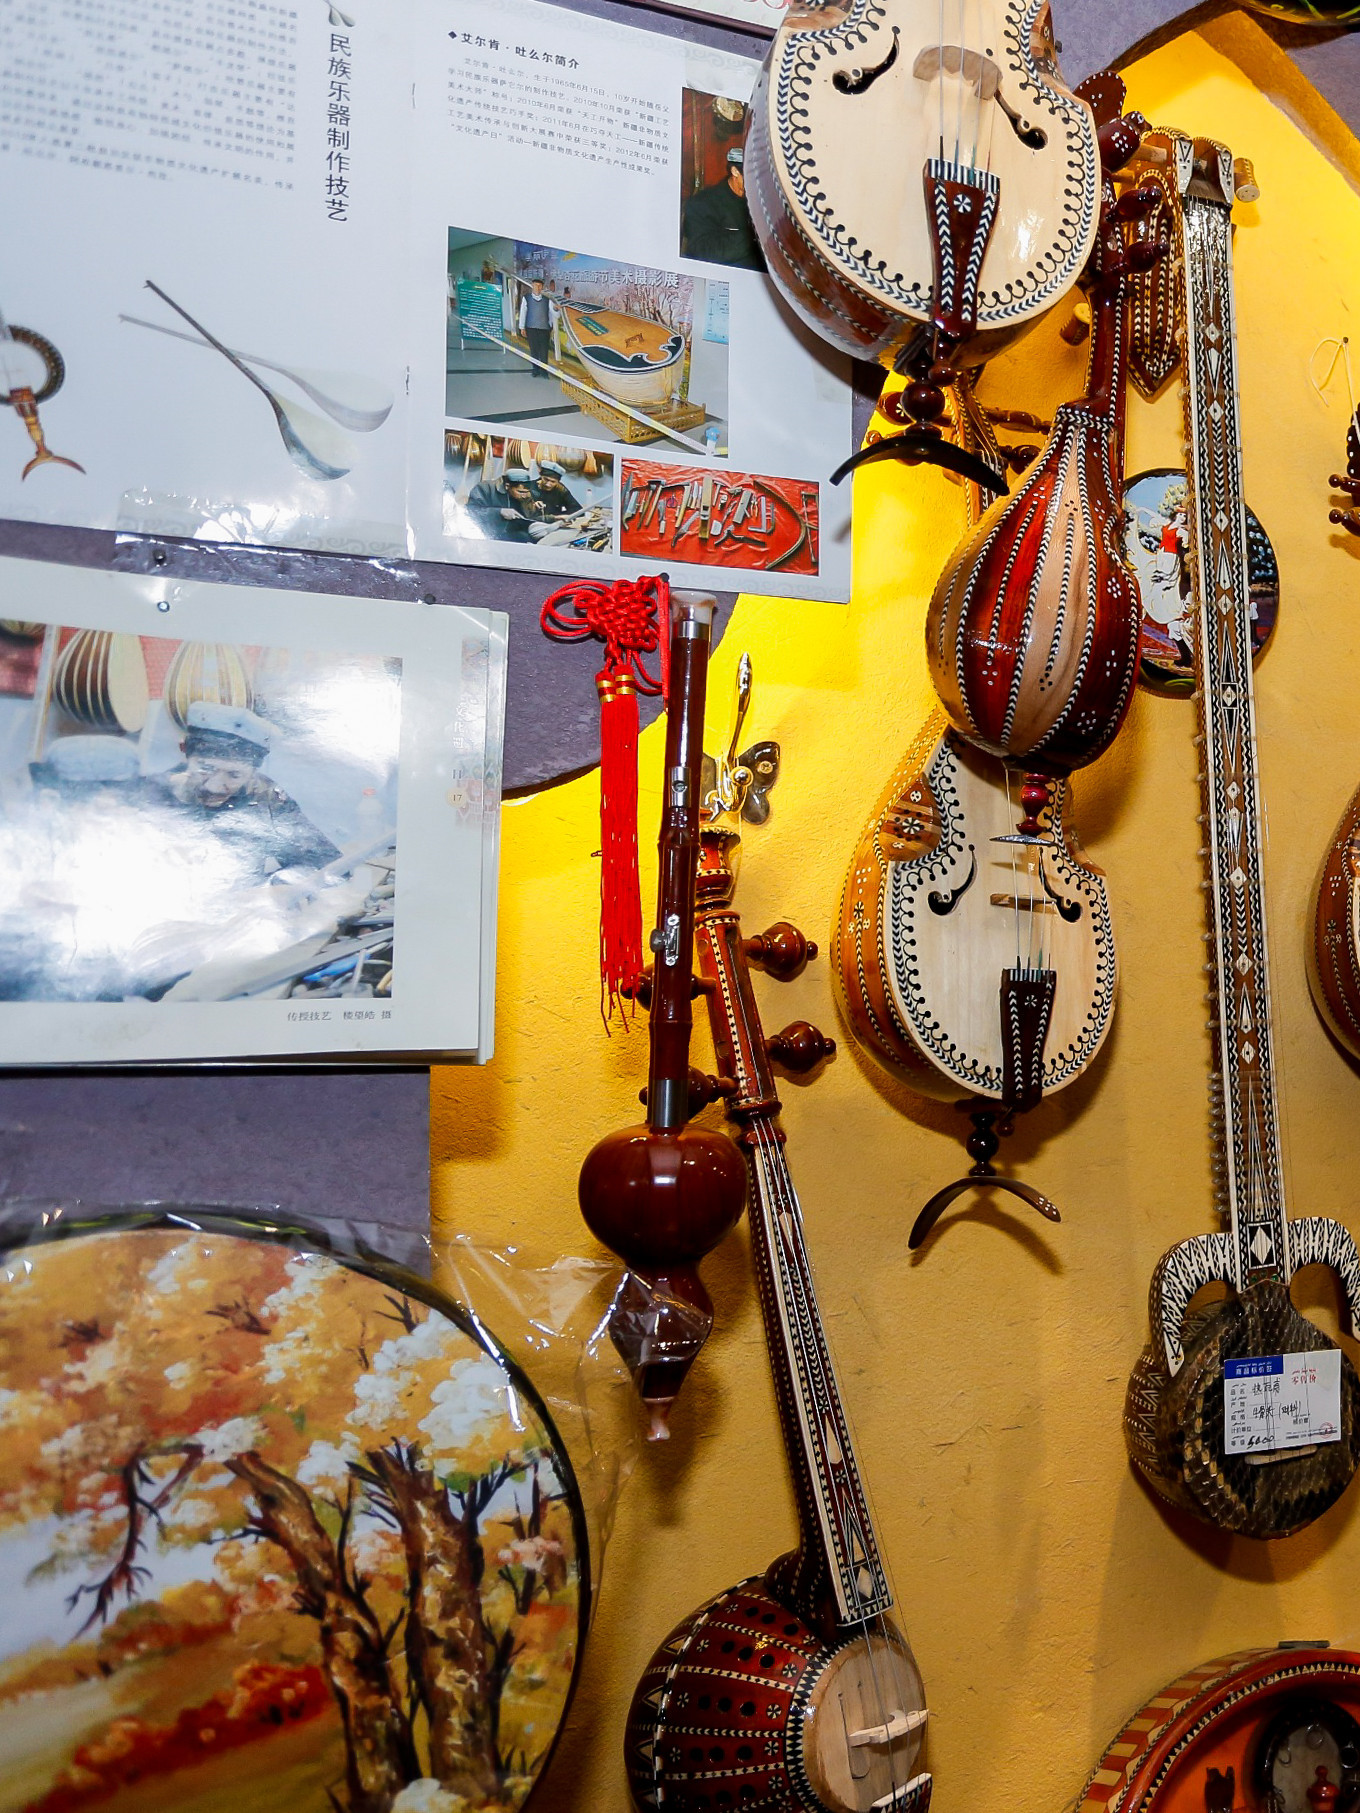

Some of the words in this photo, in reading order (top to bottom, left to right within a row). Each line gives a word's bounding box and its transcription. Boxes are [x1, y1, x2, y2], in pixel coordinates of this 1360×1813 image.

[325, 33, 352, 223] 民族乐器制作技艺
[453, 794, 462, 802] 17
[287, 1011, 332, 1022] 传授技艺
